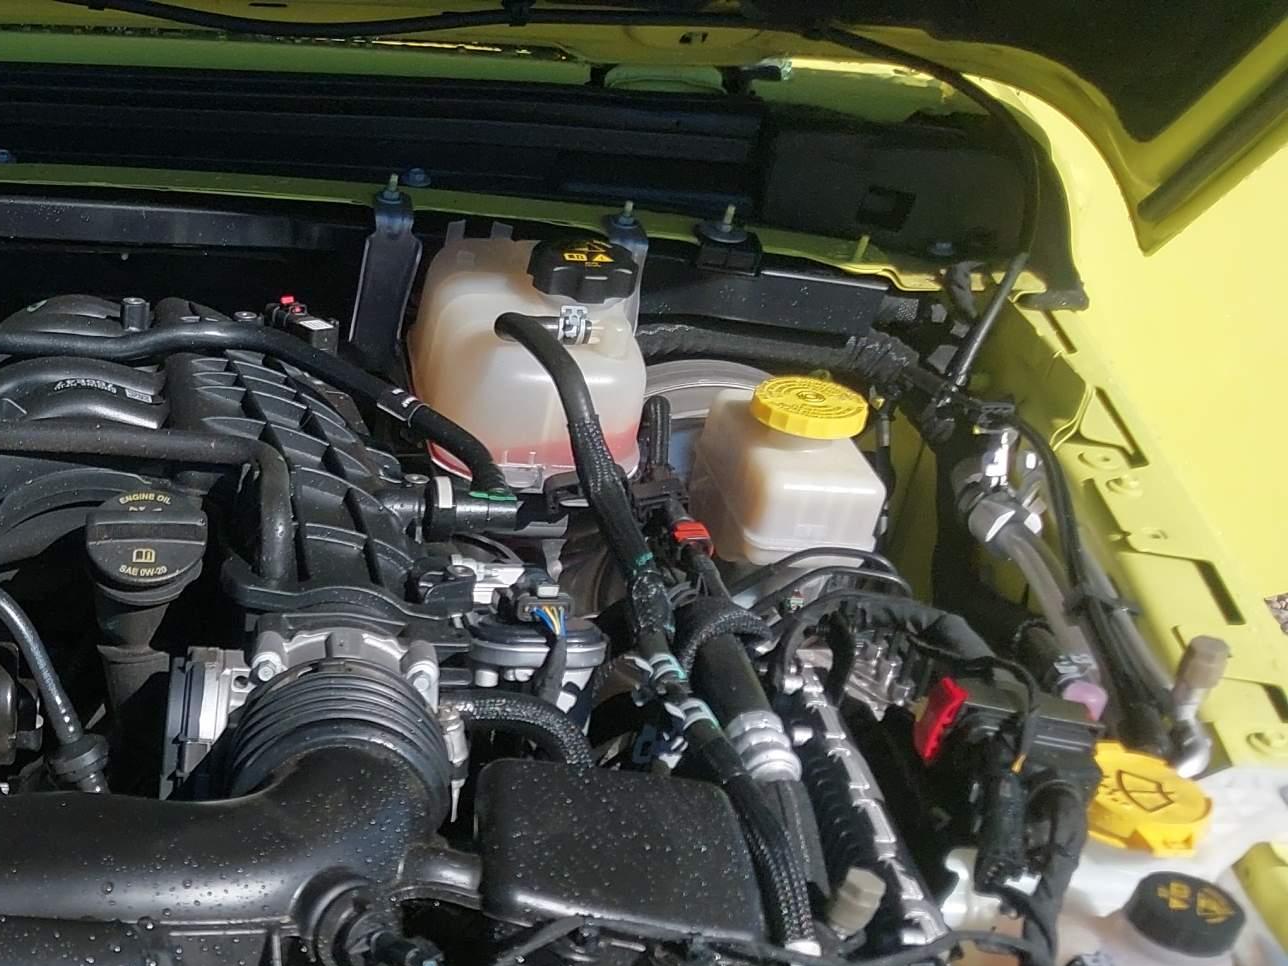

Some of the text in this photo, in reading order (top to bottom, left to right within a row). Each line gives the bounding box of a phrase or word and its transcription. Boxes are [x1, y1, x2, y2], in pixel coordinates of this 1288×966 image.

[119, 492, 172, 505] ENGINE OIL
[119, 564, 139, 576] SAE
